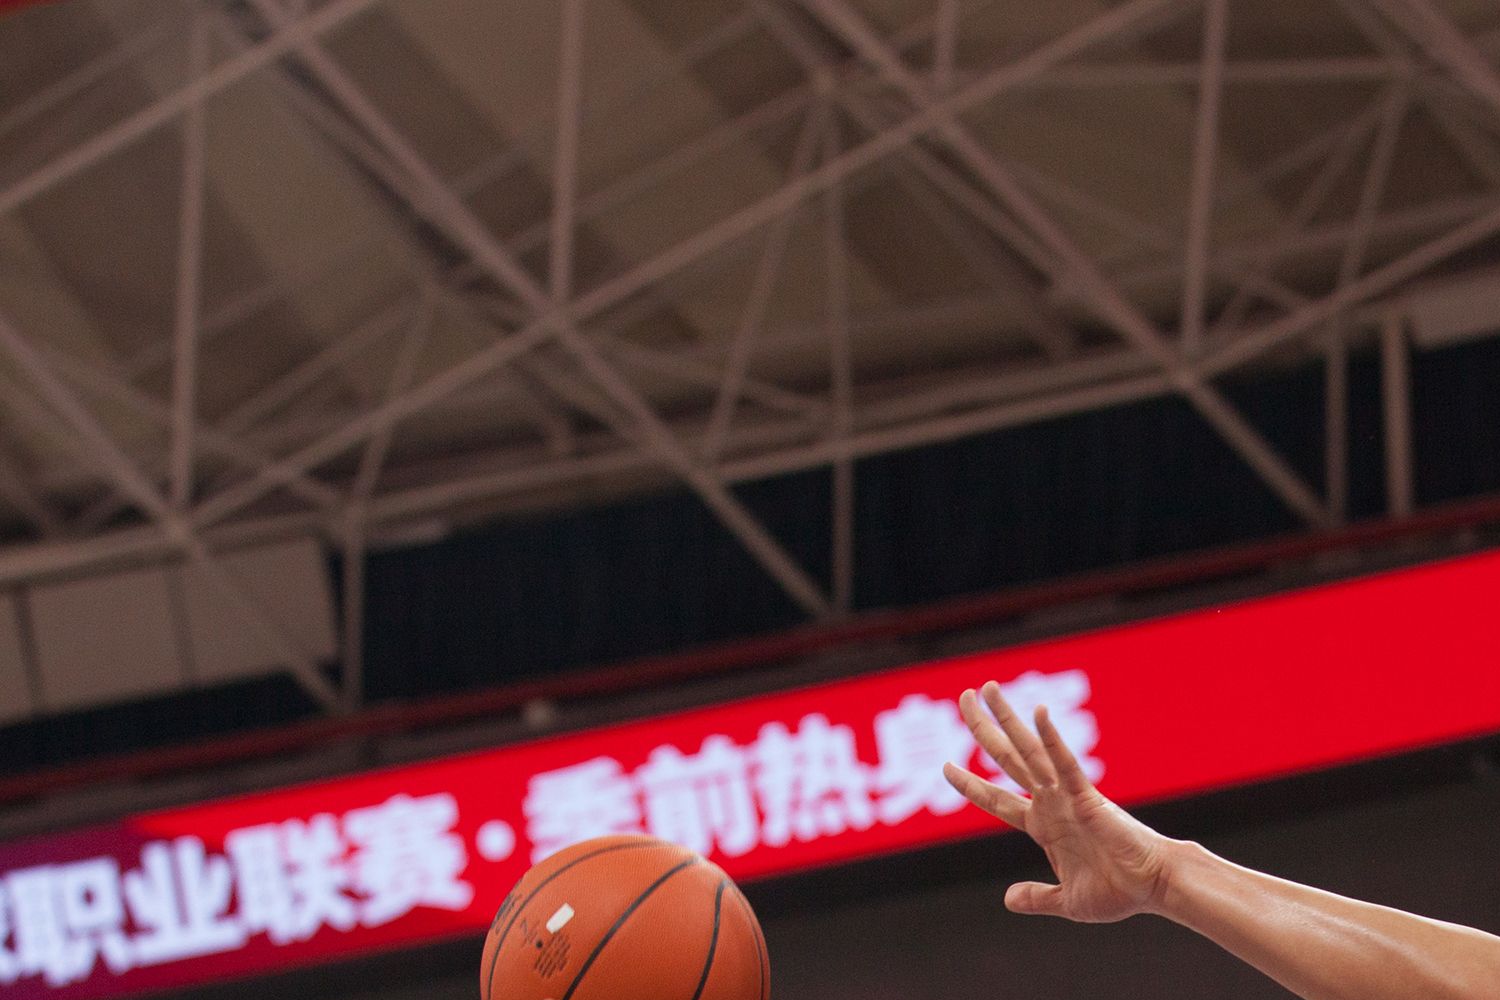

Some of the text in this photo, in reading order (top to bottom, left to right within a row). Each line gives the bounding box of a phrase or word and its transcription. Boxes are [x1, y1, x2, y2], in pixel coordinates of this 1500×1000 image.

[0, 668, 1106, 987] 职业联赛·季前热身赛
